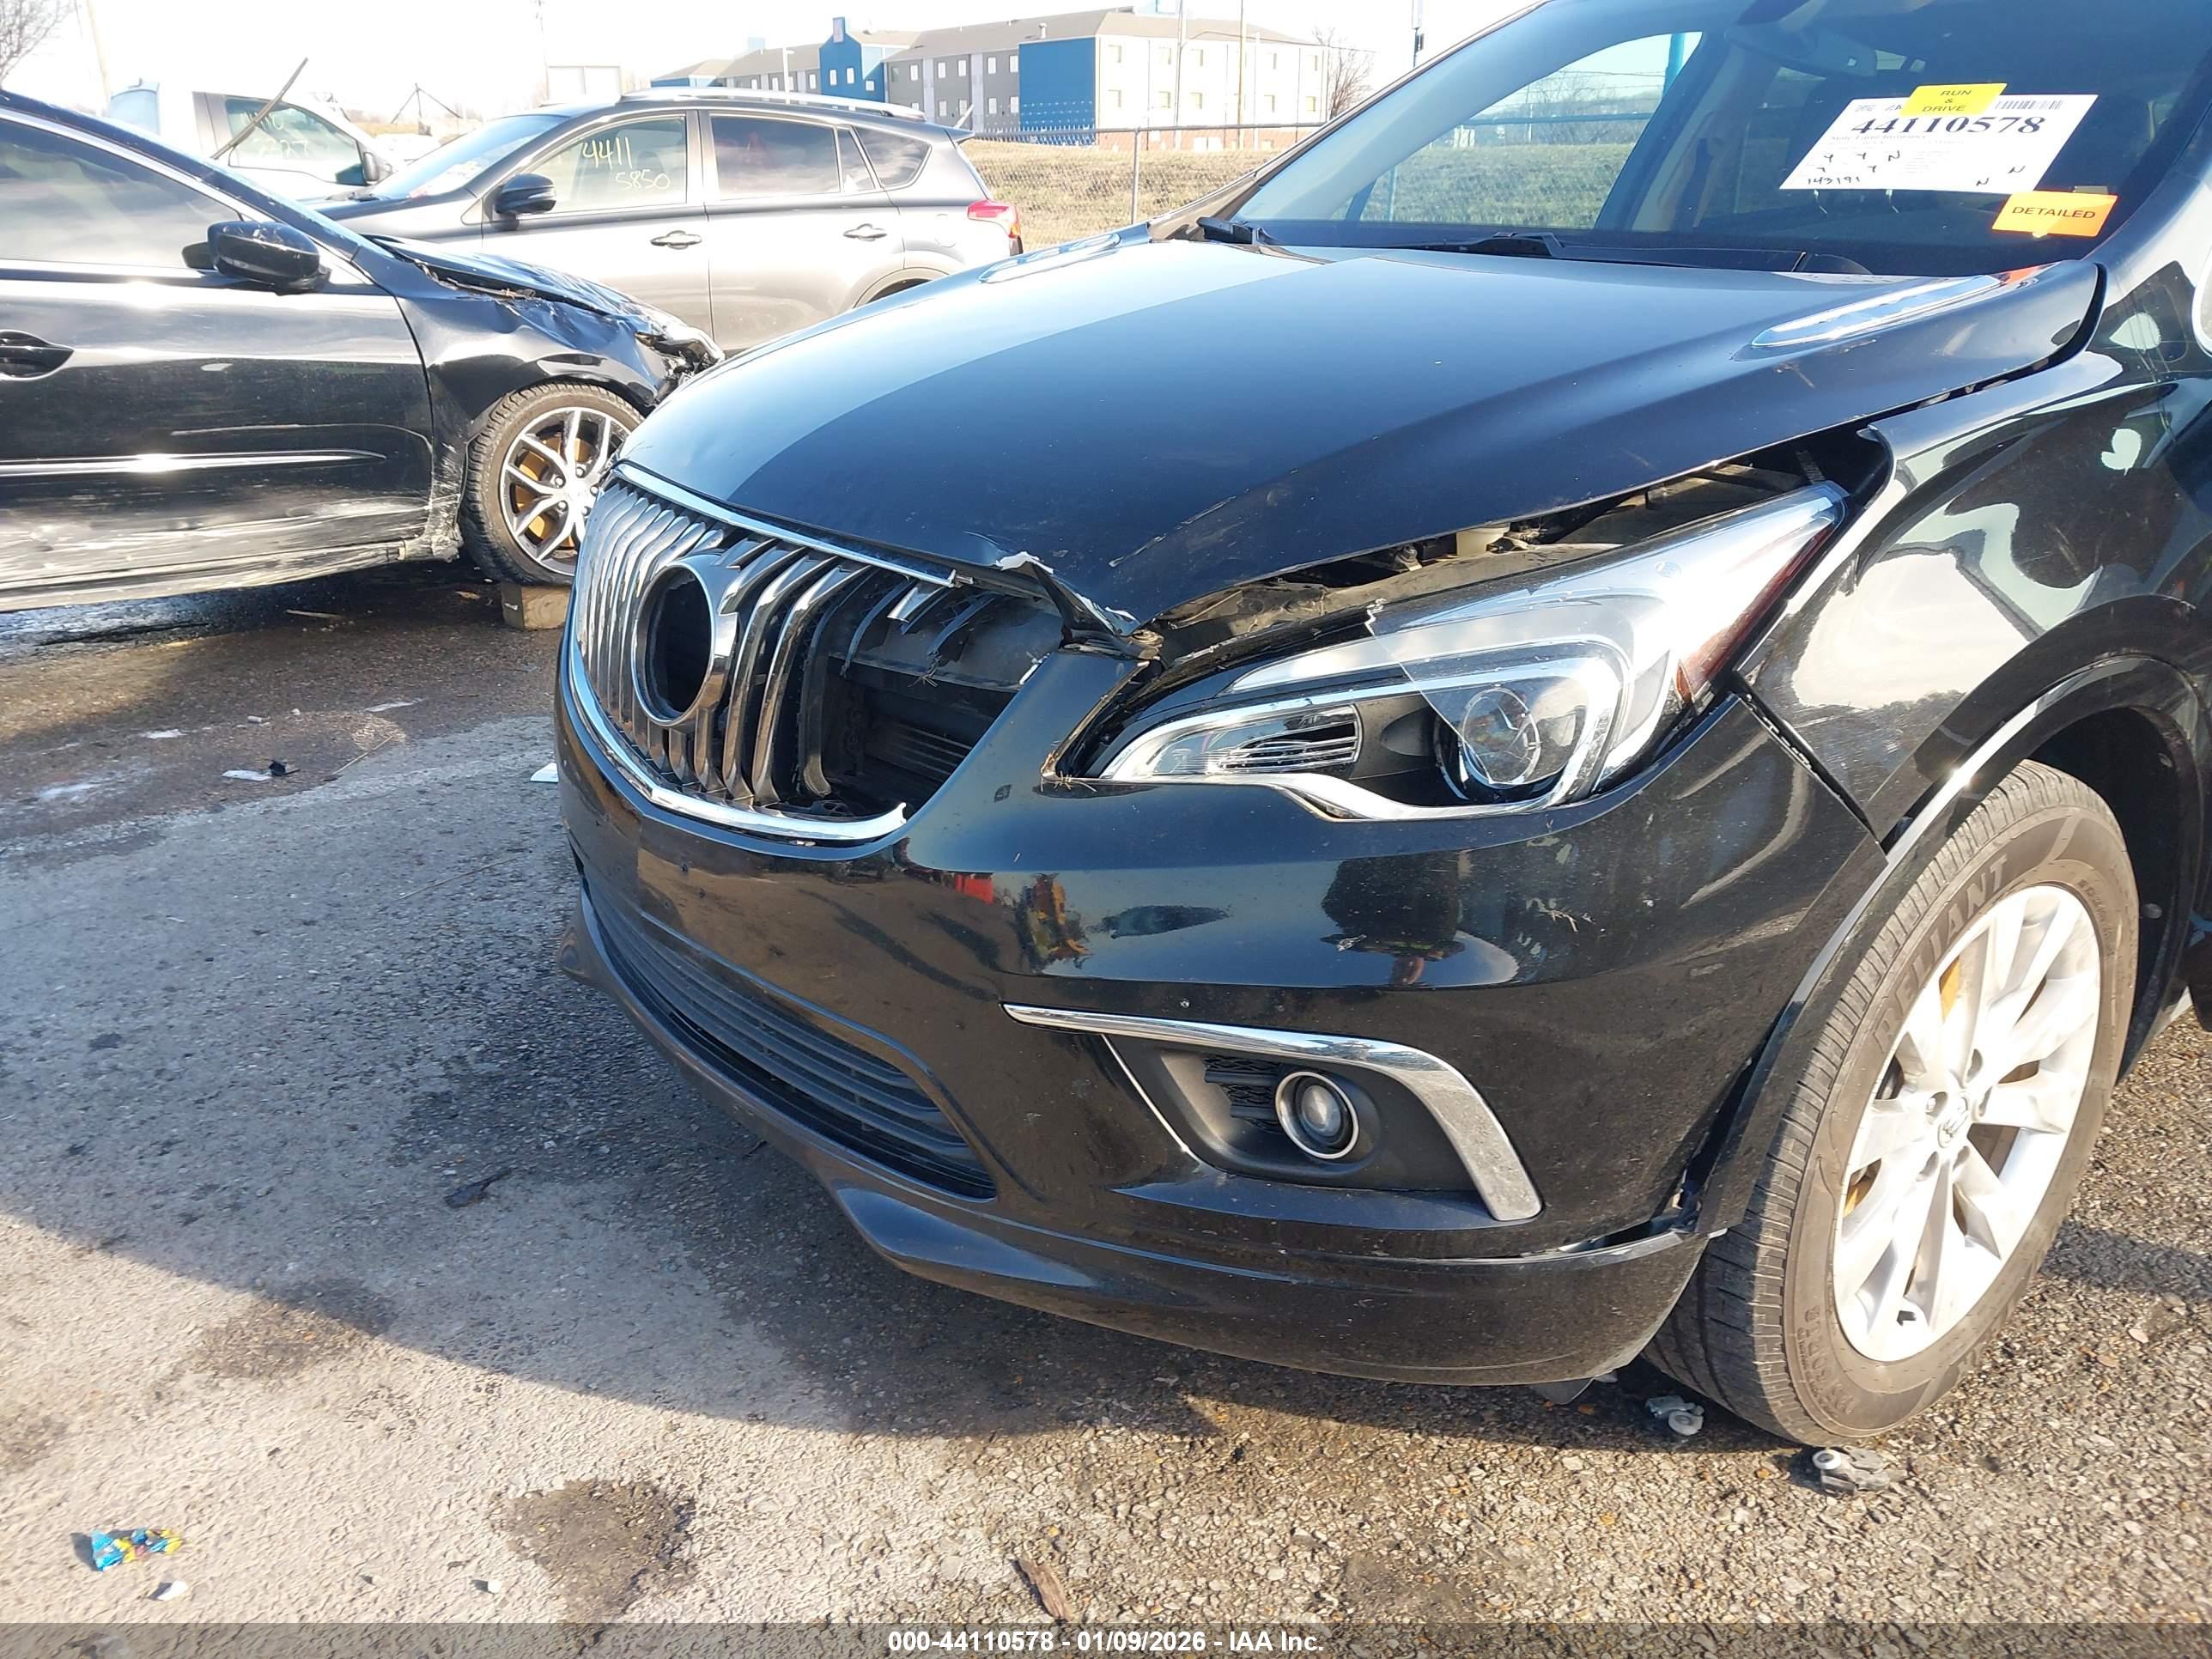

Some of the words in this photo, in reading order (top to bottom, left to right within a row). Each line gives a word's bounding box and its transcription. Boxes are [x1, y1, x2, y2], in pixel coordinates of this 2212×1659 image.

[1850, 115, 2046, 134] 44110578
[582, 137, 633, 170] 4411
[615, 168, 671, 190] 5850
[2012, 206, 2096, 219] DETAILED
[1873, 854, 2008, 1055] RELIANT
